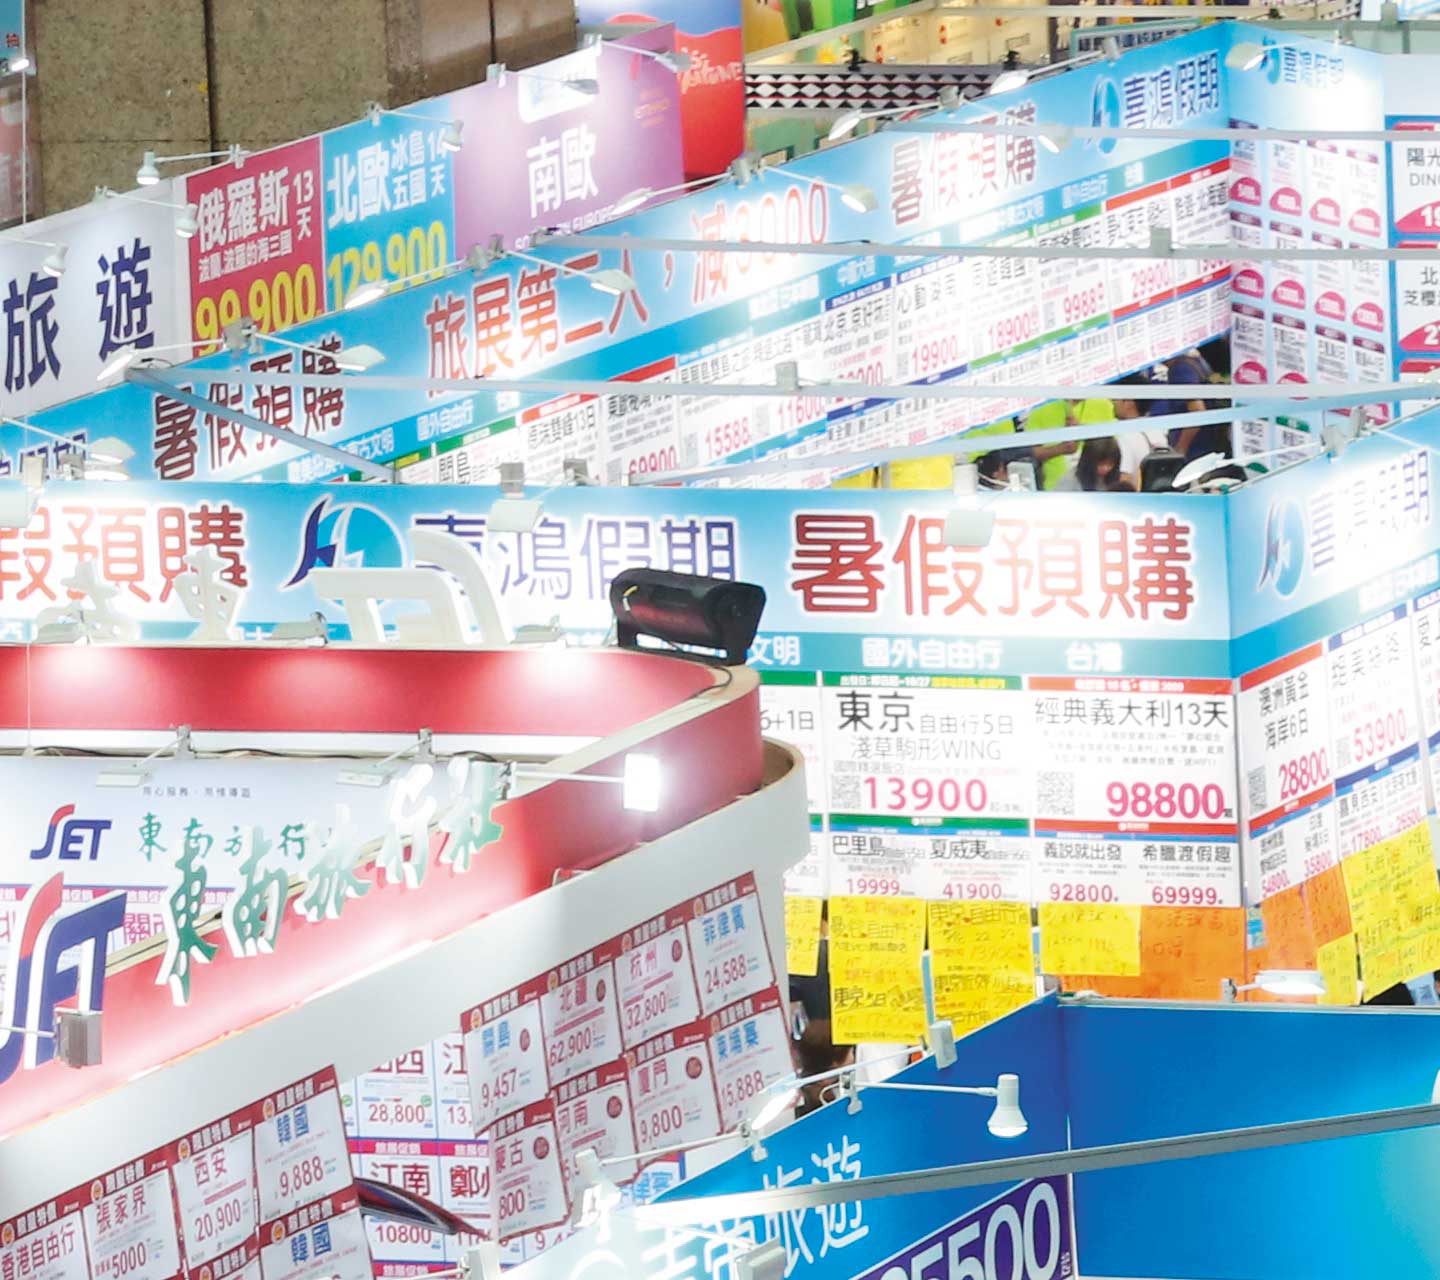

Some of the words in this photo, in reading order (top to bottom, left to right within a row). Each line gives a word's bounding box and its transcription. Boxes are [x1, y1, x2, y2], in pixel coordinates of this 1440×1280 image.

[391, 131, 424, 168] 冰島
[327, 146, 391, 228] 北歐
[524, 129, 600, 215] 南歐
[790, 510, 1194, 622] 暑假預購
[862, 638, 1002, 669] 國外自由行
[836, 691, 916, 734] 東京
[1035, 698, 1229, 730] 經典義大利13天
[849, 737, 1002, 761] 淺草駒形WING
[864, 777, 988, 812] 13900
[1106, 781, 1226, 819] 98800
[368, 1103, 426, 1124] 28,800
[279, 1155, 325, 1199] 9,888
[370, 1162, 431, 1198] 江南
